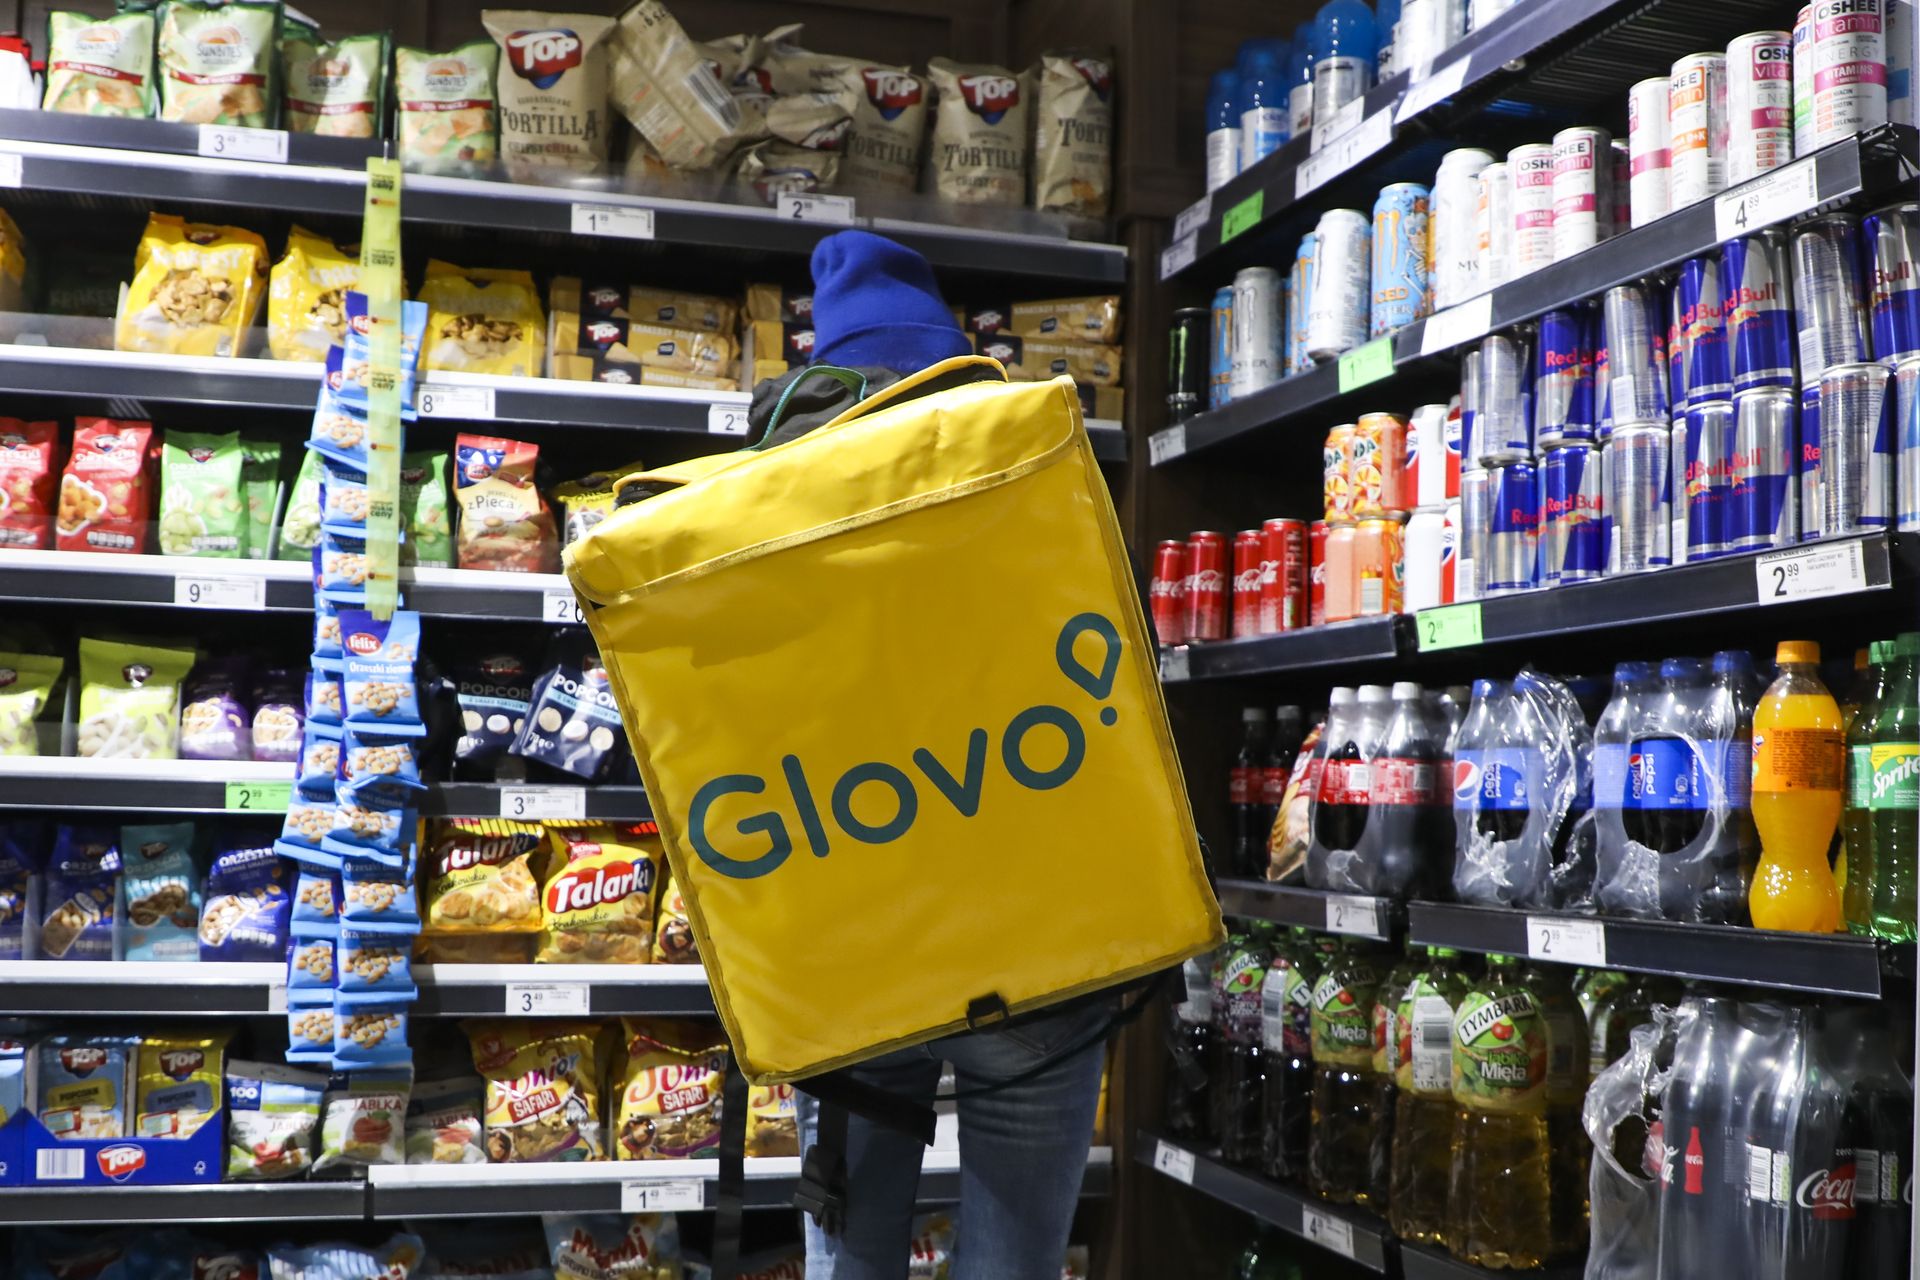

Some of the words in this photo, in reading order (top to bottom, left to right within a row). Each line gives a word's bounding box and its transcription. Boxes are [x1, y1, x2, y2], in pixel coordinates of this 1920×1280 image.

[1817, 0, 1876, 20] OSHEE
[1816, 16, 1881, 37] vitamin
[508, 30, 579, 71] TOP
[1758, 48, 1791, 61] OSH
[1754, 63, 1791, 79] vita
[1823, 64, 1873, 80] VITAMINS
[862, 70, 919, 99] TOP
[959, 76, 1017, 106] TOP
[1757, 92, 1790, 105] ENE
[499, 104, 599, 142] TORTILLA
[1765, 109, 1790, 120] VITA
[1057, 117, 1107, 147] TORT
[213, 134, 225, 153] 3
[841, 133, 918, 170] TORTILL
[943, 143, 1020, 172] TORTILL
[1520, 157, 1554, 172] OSH
[1517, 171, 1550, 187] vita
[792, 201, 803, 219] 2
[1735, 200, 1748, 228] 4
[587, 213, 597, 231] 1
[1739, 281, 1777, 304] Bull
[790, 295, 813, 314] TO
[587, 320, 620, 341] TOP
[972, 310, 1002, 331] TOP
[790, 330, 815, 350] TO
[1545, 348, 1577, 368] Red
[422, 394, 433, 413] 8
[724, 413, 735, 431] 2
[1803, 442, 1822, 463] Re
[475, 495, 514, 510] Pieca
[1547, 493, 1574, 513] Red
[369, 511, 393, 520] ceny
[1772, 566, 1788, 597] 2
[1787, 563, 1799, 577] 99
[189, 583, 200, 603] 9
[558, 599, 568, 618] 2
[349, 635, 378, 650] felix
[1427, 621, 1437, 644] 2
[349, 661, 384, 674] Orzeszki
[459, 681, 531, 700] POPCOR
[553, 673, 619, 711] POPCO
[1632, 768, 1642, 800] pepsi
[1645, 753, 1657, 795] pepsi
[1872, 755, 1919, 799] Sprite
[239, 789, 250, 809] 2
[688, 705, 1086, 880] Glovo
[514, 796, 525, 815] 3
[441, 834, 530, 873] Talarki
[554, 863, 650, 914] Talarki
[1335, 905, 1343, 928] 2
[1541, 929, 1551, 954] 2
[521, 993, 532, 1012] 3
[1459, 994, 1533, 1039] TYMBARK
[1331, 1023, 1367, 1041] Mięta
[160, 1051, 202, 1071] TOP
[1481, 1061, 1527, 1082] Mięta
[59, 1086, 99, 1101] POPCORN
[229, 1086, 257, 1099] 100
[663, 1086, 704, 1111] SAFARI
[513, 1091, 555, 1119] SAFARI
[100, 1147, 143, 1173] TOP
[638, 1190, 647, 1209] 1
[1309, 1216, 1318, 1237] 4
